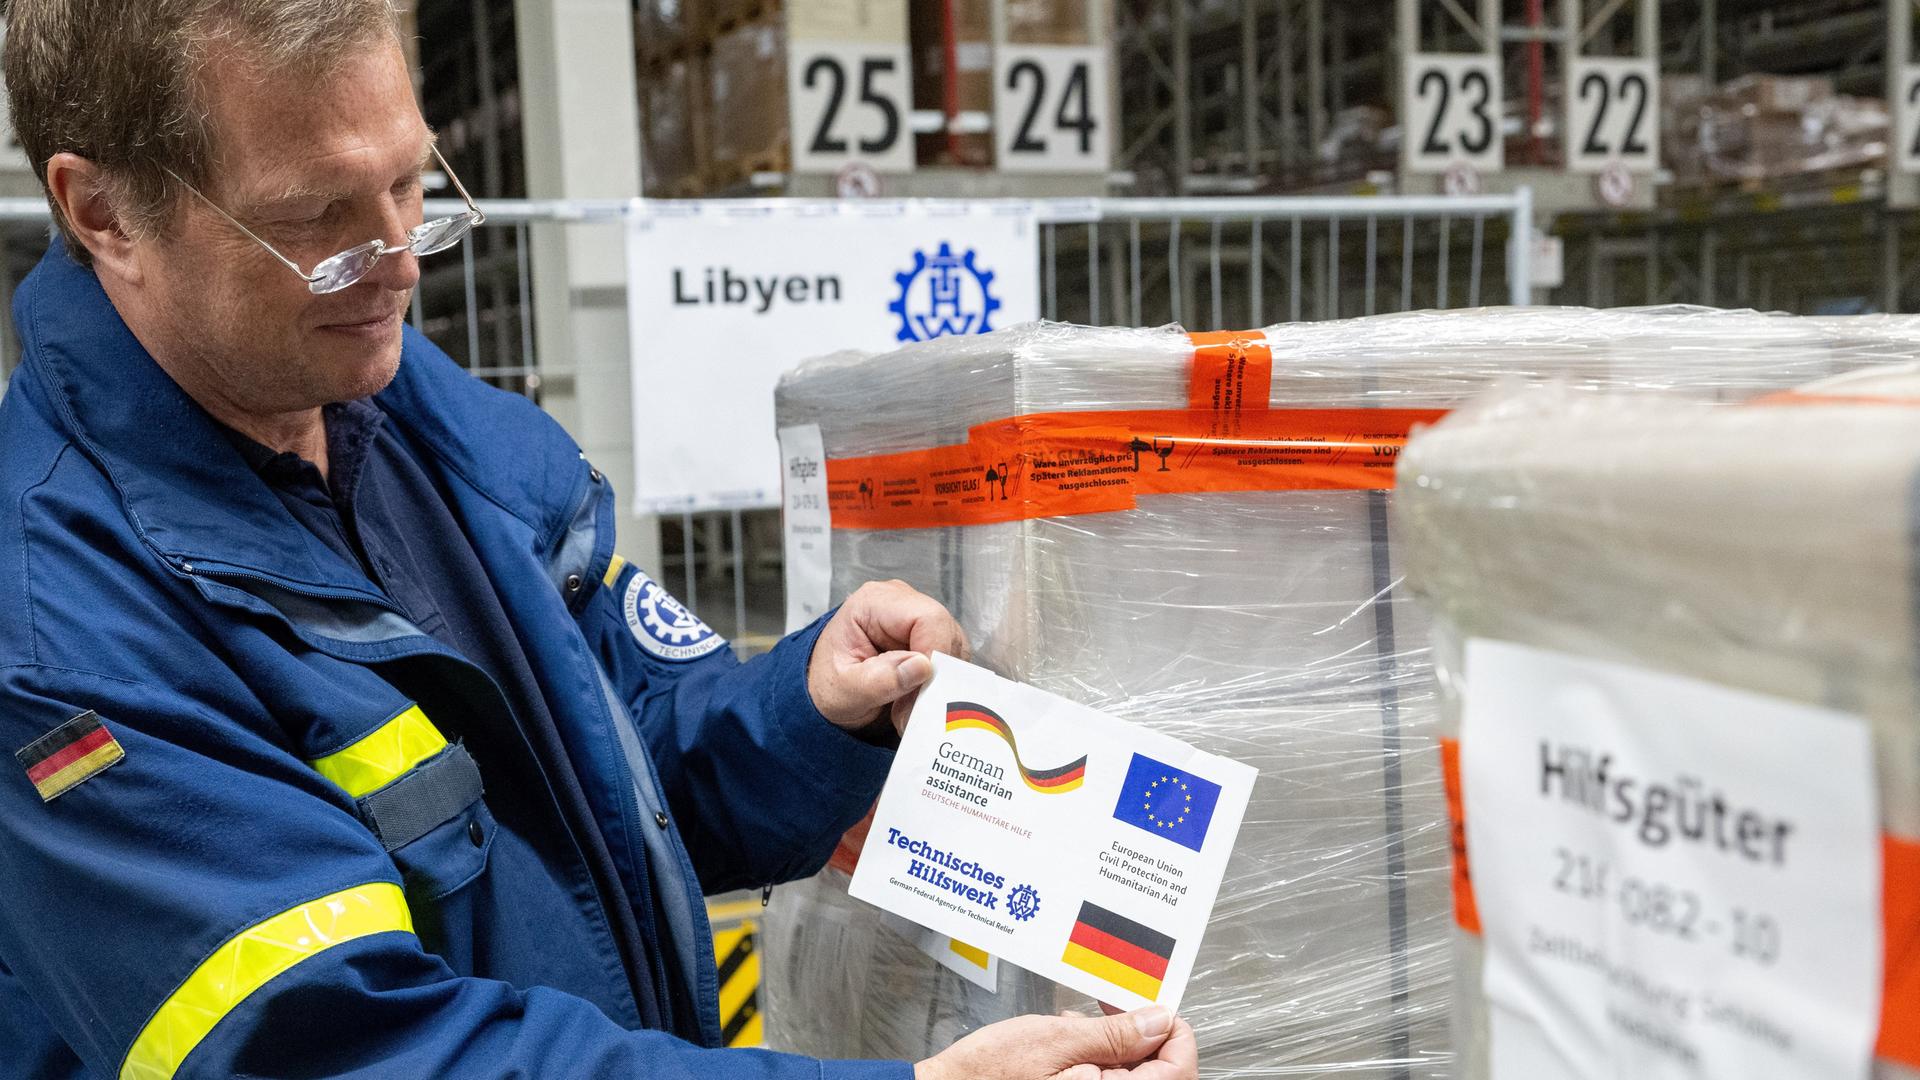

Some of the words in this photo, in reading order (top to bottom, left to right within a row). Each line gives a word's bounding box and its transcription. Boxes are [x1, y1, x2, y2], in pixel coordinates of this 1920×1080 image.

[804, 58, 899, 153] 25
[1007, 60, 1096, 153] 24
[1419, 71, 1492, 154] 23
[1580, 73, 1648, 154] 22
[673, 268, 842, 314] Libyen
[1033, 459, 1057, 469] Ware
[1058, 454, 1115, 468] unverzüglich
[1212, 447, 1246, 457] Spätere
[1247, 447, 1312, 456] Reklamationen
[1313, 447, 1332, 455] sind
[1238, 457, 1305, 467] ausgeschlossen.
[1030, 471, 1066, 483] Spätere
[1058, 478, 1129, 491] ausgeschlossen.
[931, 758, 1014, 801] humanitarian
[938, 741, 1005, 781] German
[926, 775, 989, 807] assistance
[1540, 741, 1795, 870] Hilfsgüter
[921, 788, 960, 810] DEUTSCHE
[961, 804, 1010, 831] HUMANITÄRE
[1010, 825, 1033, 840] HILFE
[887, 827, 1006, 890] Technisches
[1099, 851, 1120, 867] Civil
[1121, 859, 1168, 888] Protection
[1169, 881, 1188, 895] and
[1111, 840, 1155, 866] European
[1156, 859, 1184, 878] Union
[889, 877, 913, 892] German
[913, 886, 935, 901] Federal
[935, 896, 957, 912] Agency
[957, 905, 967, 915] for
[967, 909, 996, 928] Technical
[996, 922, 1015, 935] Relief
[907, 858, 999, 911] Hilfswerk
[1099, 866, 1161, 899] Humanitarian
[1161, 893, 1178, 907] Aid
